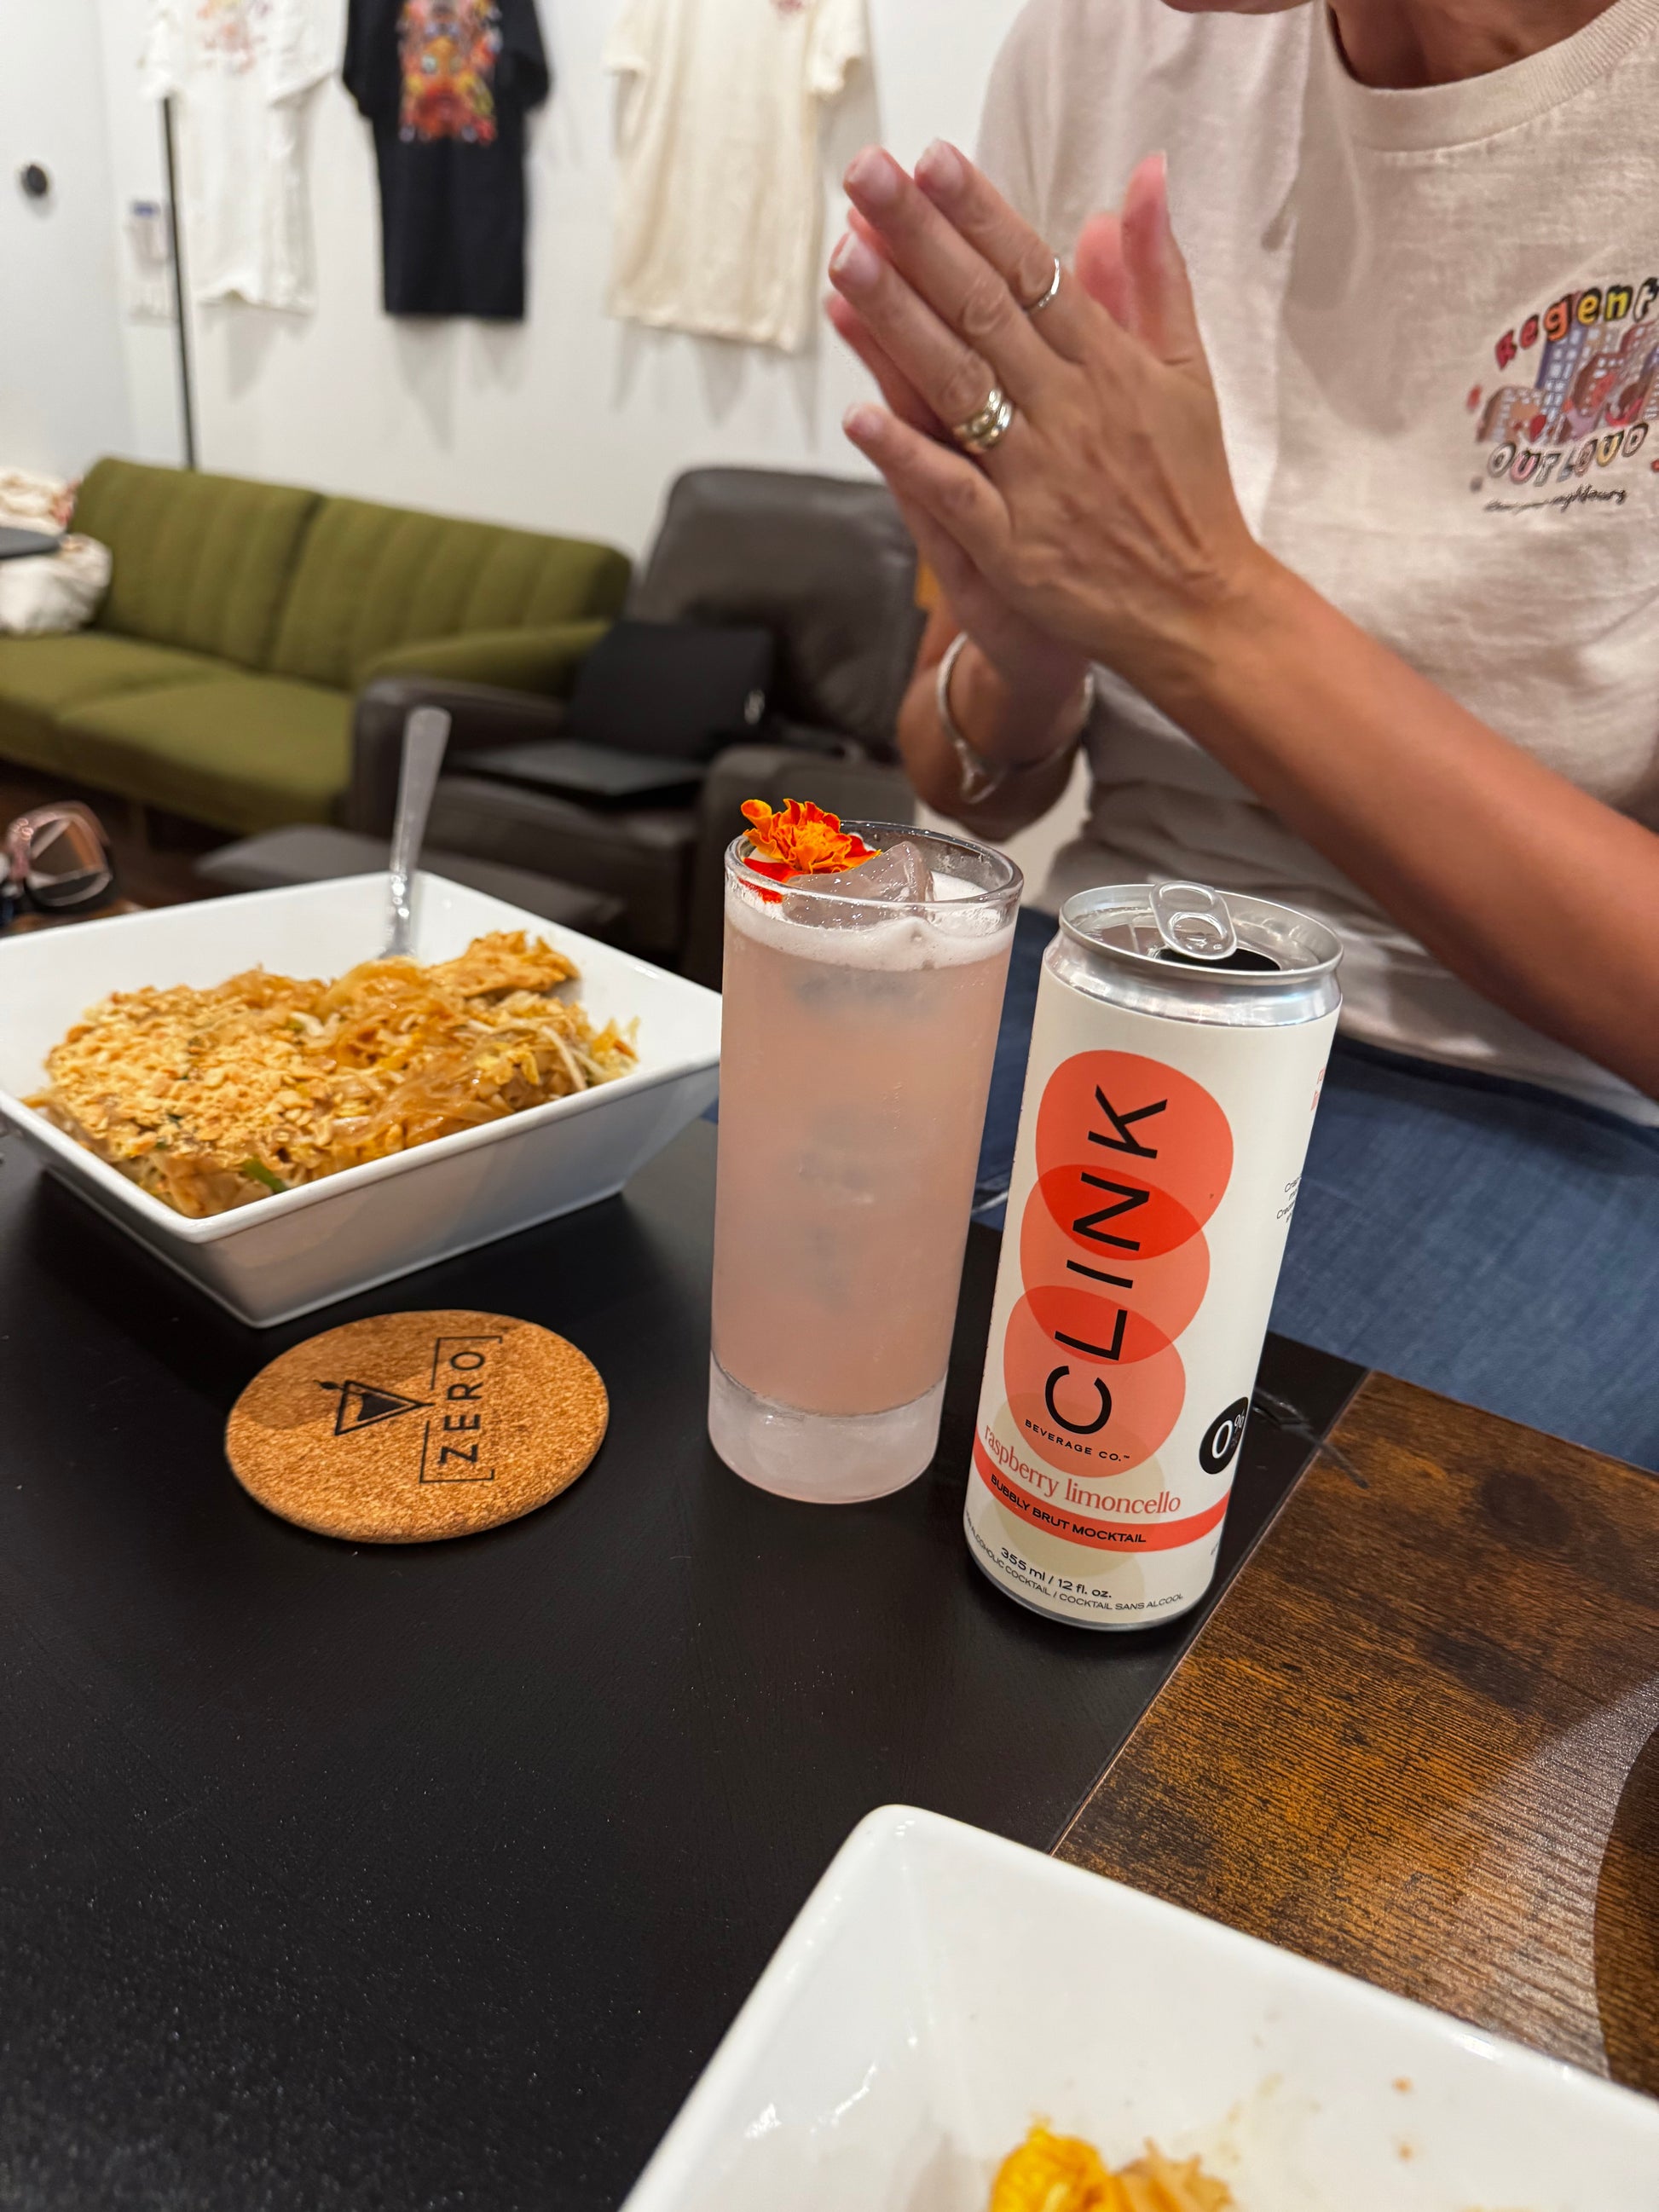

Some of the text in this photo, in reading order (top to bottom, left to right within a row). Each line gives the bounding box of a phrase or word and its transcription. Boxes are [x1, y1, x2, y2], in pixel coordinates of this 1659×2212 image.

[1044, 1084, 1168, 1435] CLINK
[437, 1350, 485, 1465] ZERO
[1025, 1418, 1093, 1455] BEVERAGE
[985, 1424, 1181, 1515] raspberry limoncello
[991, 1473, 1146, 1543] BUBBLY BRUT MOCKTAIL
[1001, 1547, 1113, 1598] 355 ml / 12 fl. oz.
[1005, 1565, 1051, 1597] COCKTAIL
[1059, 1592, 1113, 1610] COCKTAIL
[1114, 1603, 1145, 1611] SANS
[1146, 1592, 1184, 1609] ALCOOL
